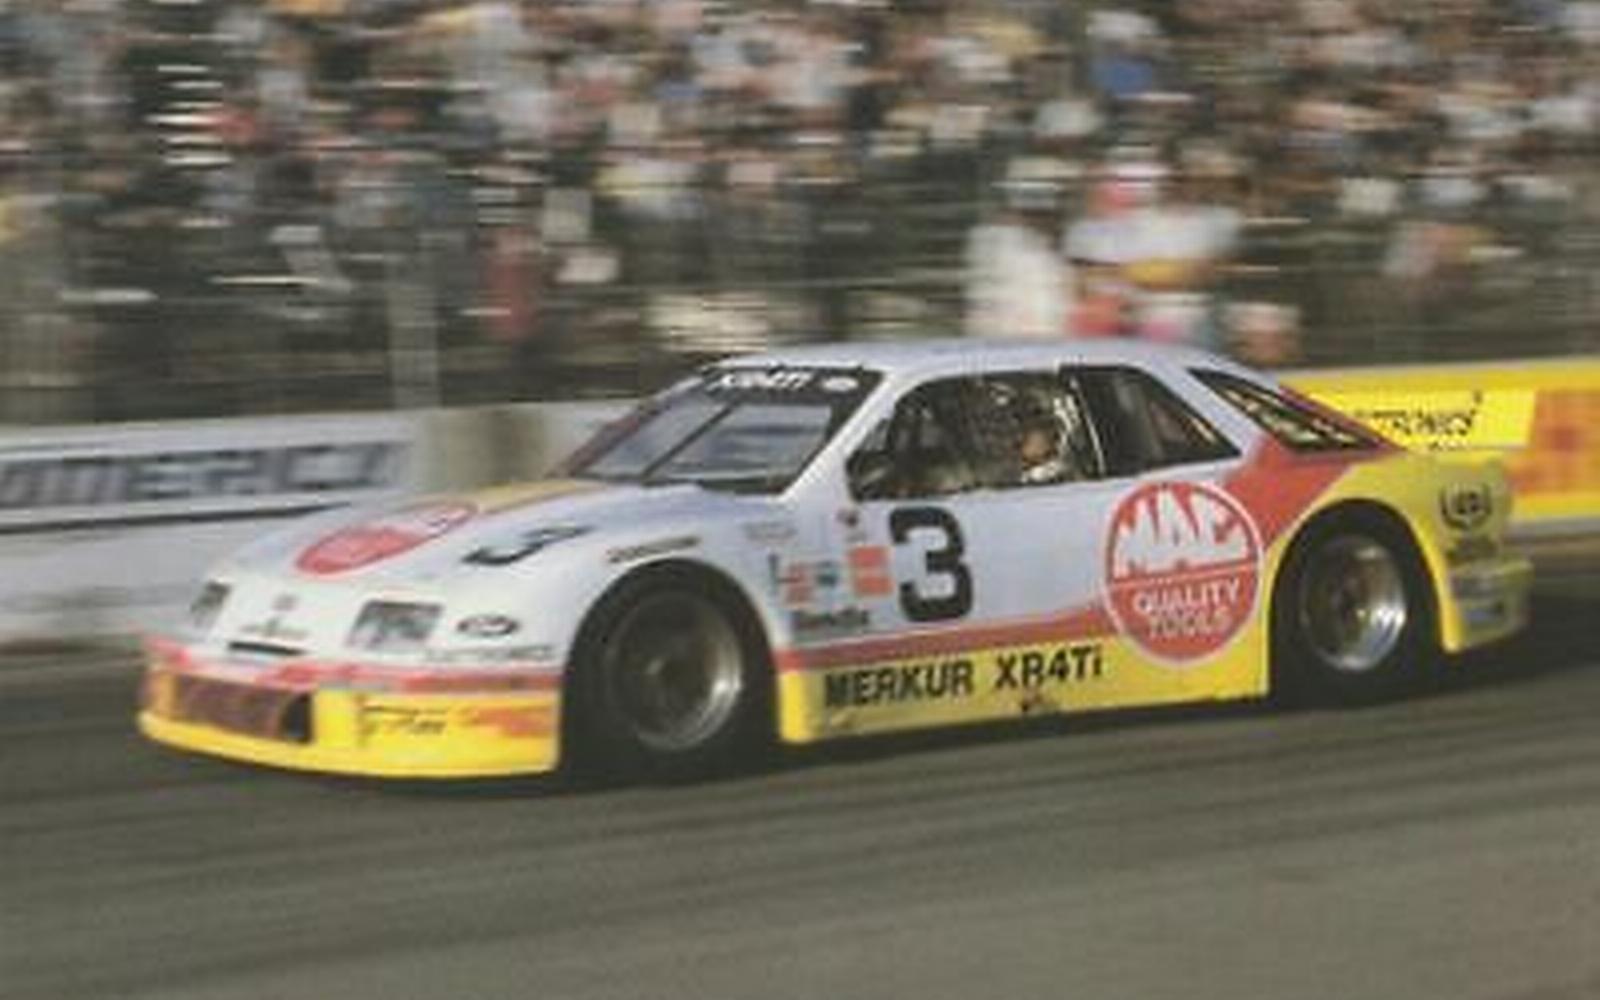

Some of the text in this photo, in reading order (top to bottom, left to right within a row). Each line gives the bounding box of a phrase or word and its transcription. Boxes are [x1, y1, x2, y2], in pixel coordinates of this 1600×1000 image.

[889, 506, 973, 622] 3
[1113, 484, 1249, 580] MAC
[1134, 577, 1241, 615] QUALITY
[825, 643, 1102, 707] MERKUR XR4Ti
